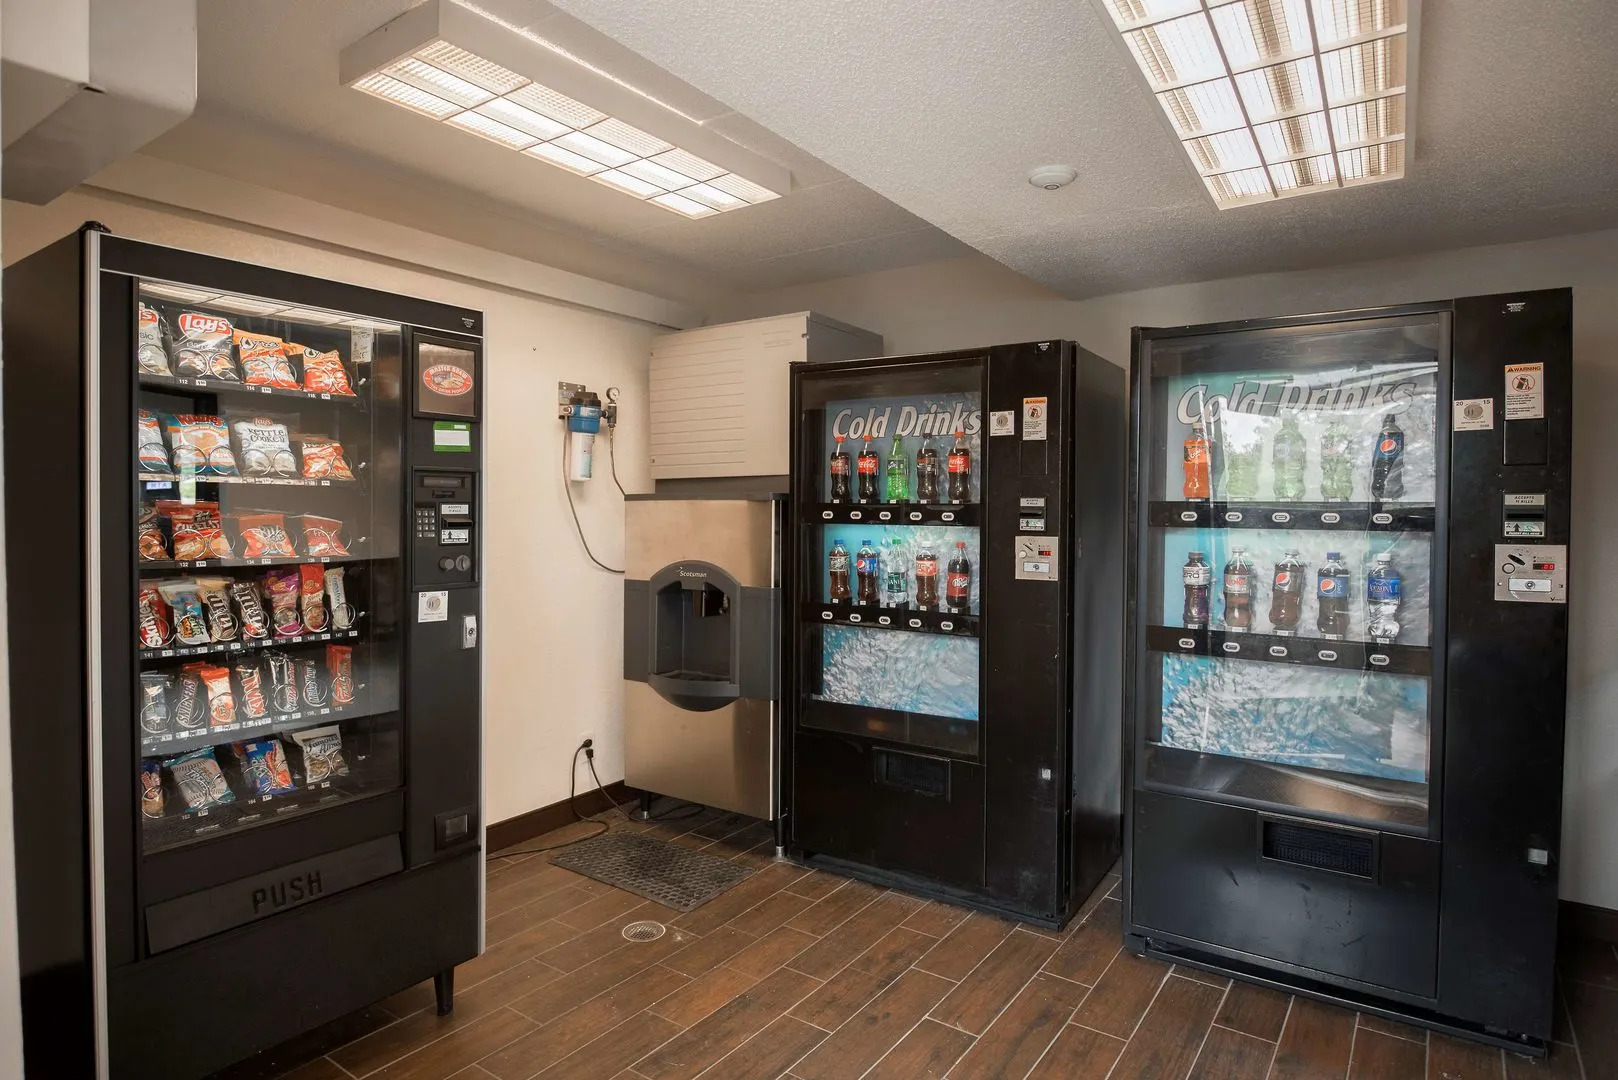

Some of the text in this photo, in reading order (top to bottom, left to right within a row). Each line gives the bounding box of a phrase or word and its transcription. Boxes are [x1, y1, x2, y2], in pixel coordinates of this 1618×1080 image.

[184, 315, 228, 334] Lay's
[1514, 365, 1542, 373] WARNING
[1176, 375, 1417, 426] Cold Drinks
[248, 428, 285, 437] KETTLE
[832, 402, 982, 440] Cold Drinks
[250, 434, 286, 443] COOKED
[679, 570, 708, 578] Scotsman
[177, 680, 198, 724] SNICKERS
[241, 671, 265, 714] TWIX
[252, 870, 322, 914] PUSH
